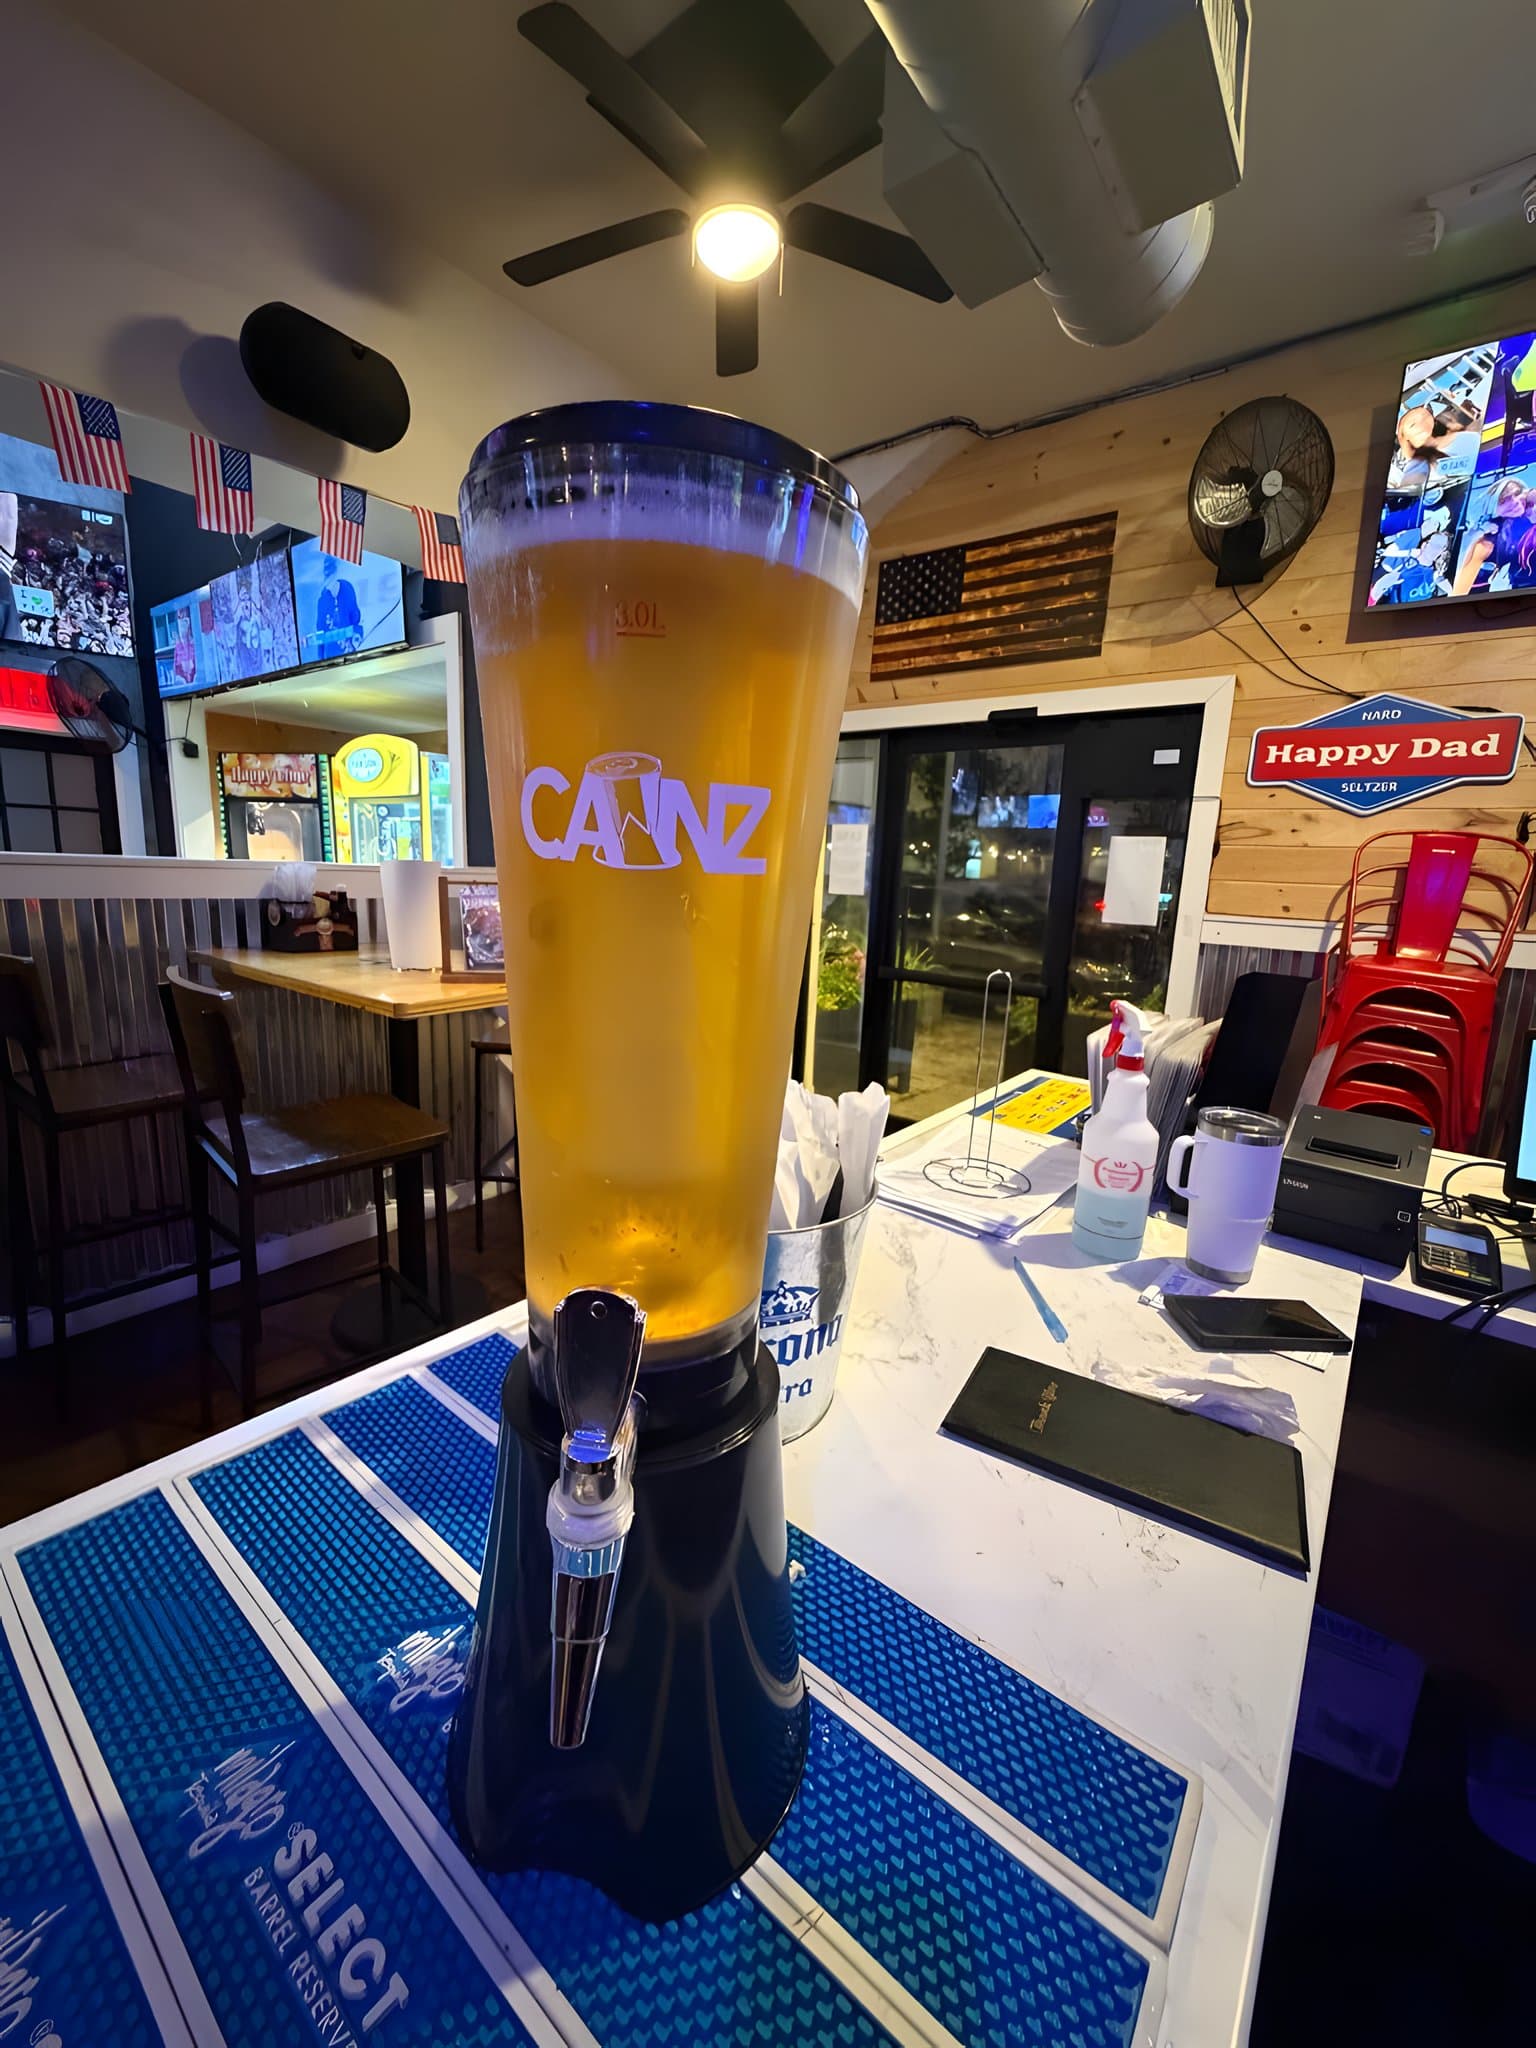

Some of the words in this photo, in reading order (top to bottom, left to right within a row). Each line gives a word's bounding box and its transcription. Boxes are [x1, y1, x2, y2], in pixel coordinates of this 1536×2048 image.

[1265, 743, 1400, 768] Happy
[1407, 733, 1500, 759] Dad
[520, 764, 771, 875] CANZ
[243, 1865, 298, 1953] BARREL
[273, 1828, 410, 2033] SELECT
